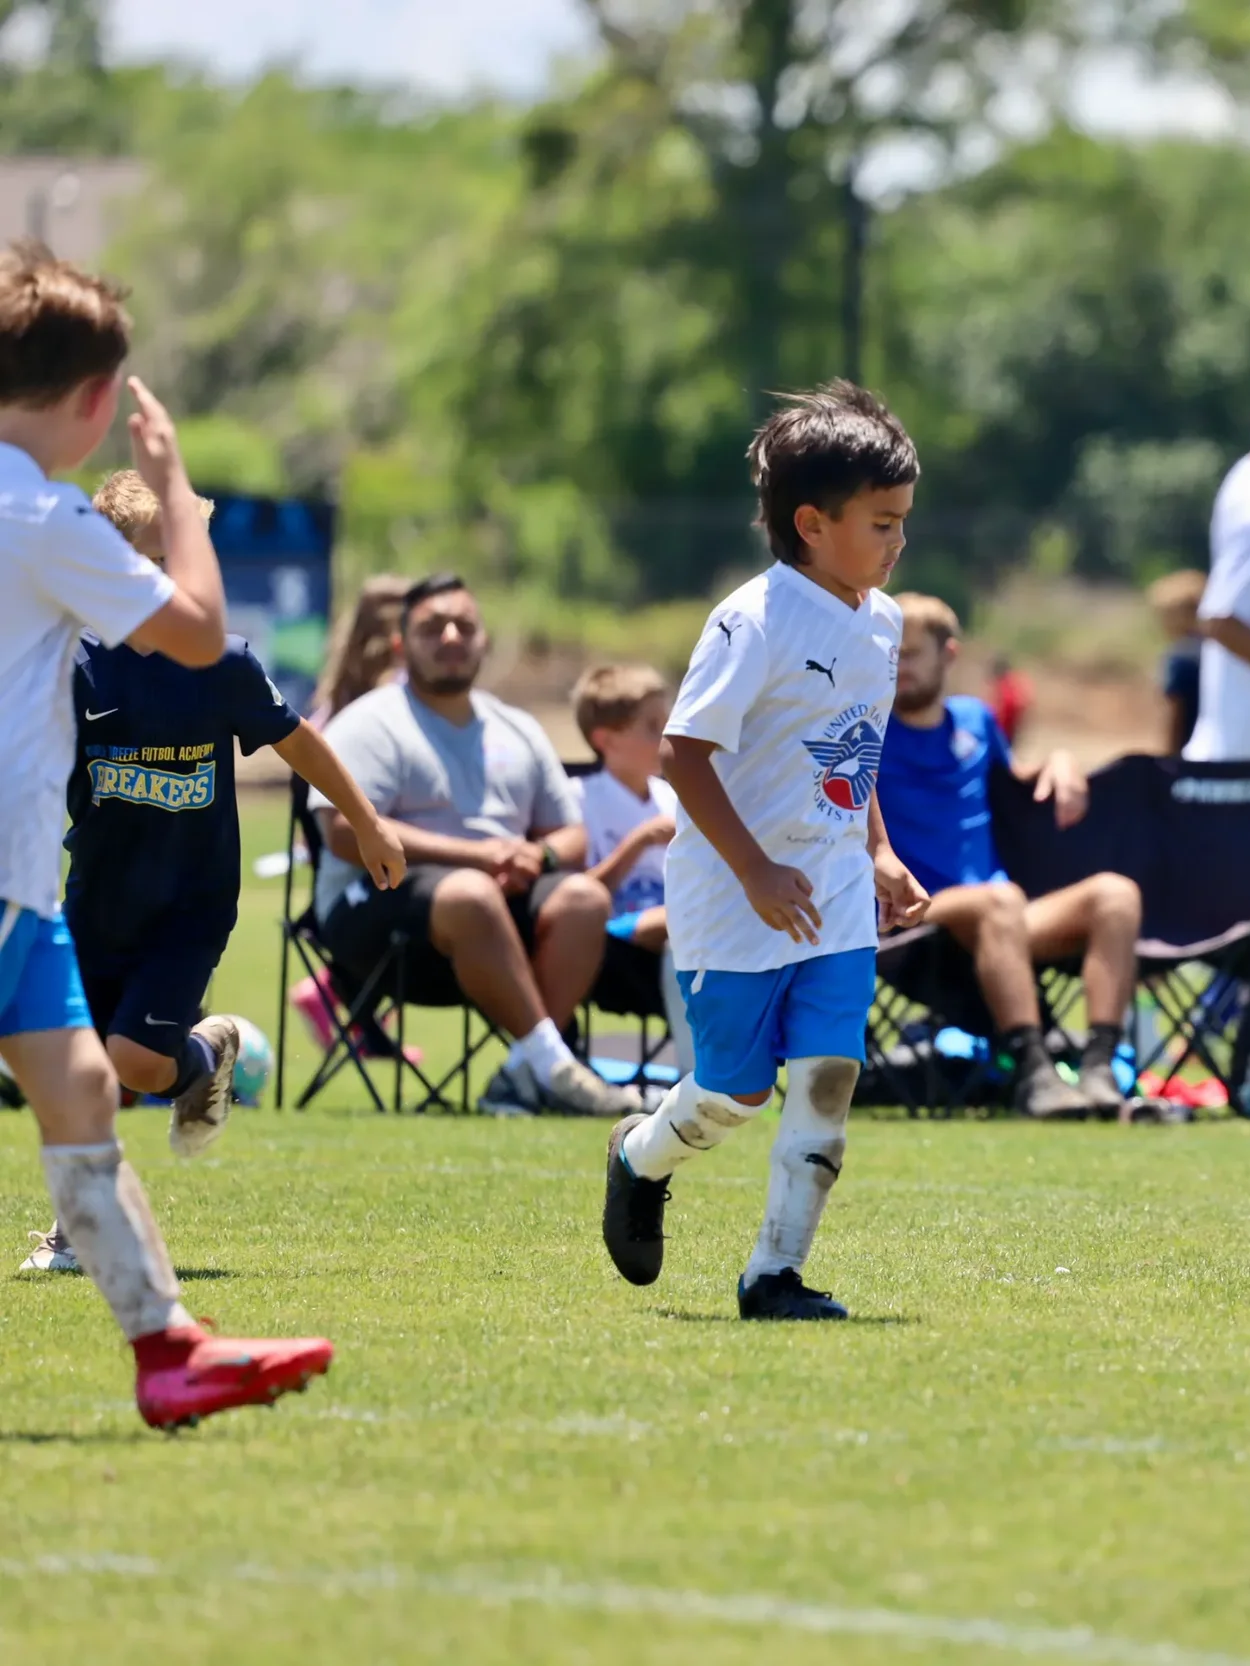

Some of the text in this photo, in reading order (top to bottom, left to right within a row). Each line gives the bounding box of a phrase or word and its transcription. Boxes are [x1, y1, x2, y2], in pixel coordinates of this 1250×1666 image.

[824, 704, 868, 739] UNITED
[142, 747, 176, 761] FUTBOL
[178, 743, 214, 761] ACADEMY
